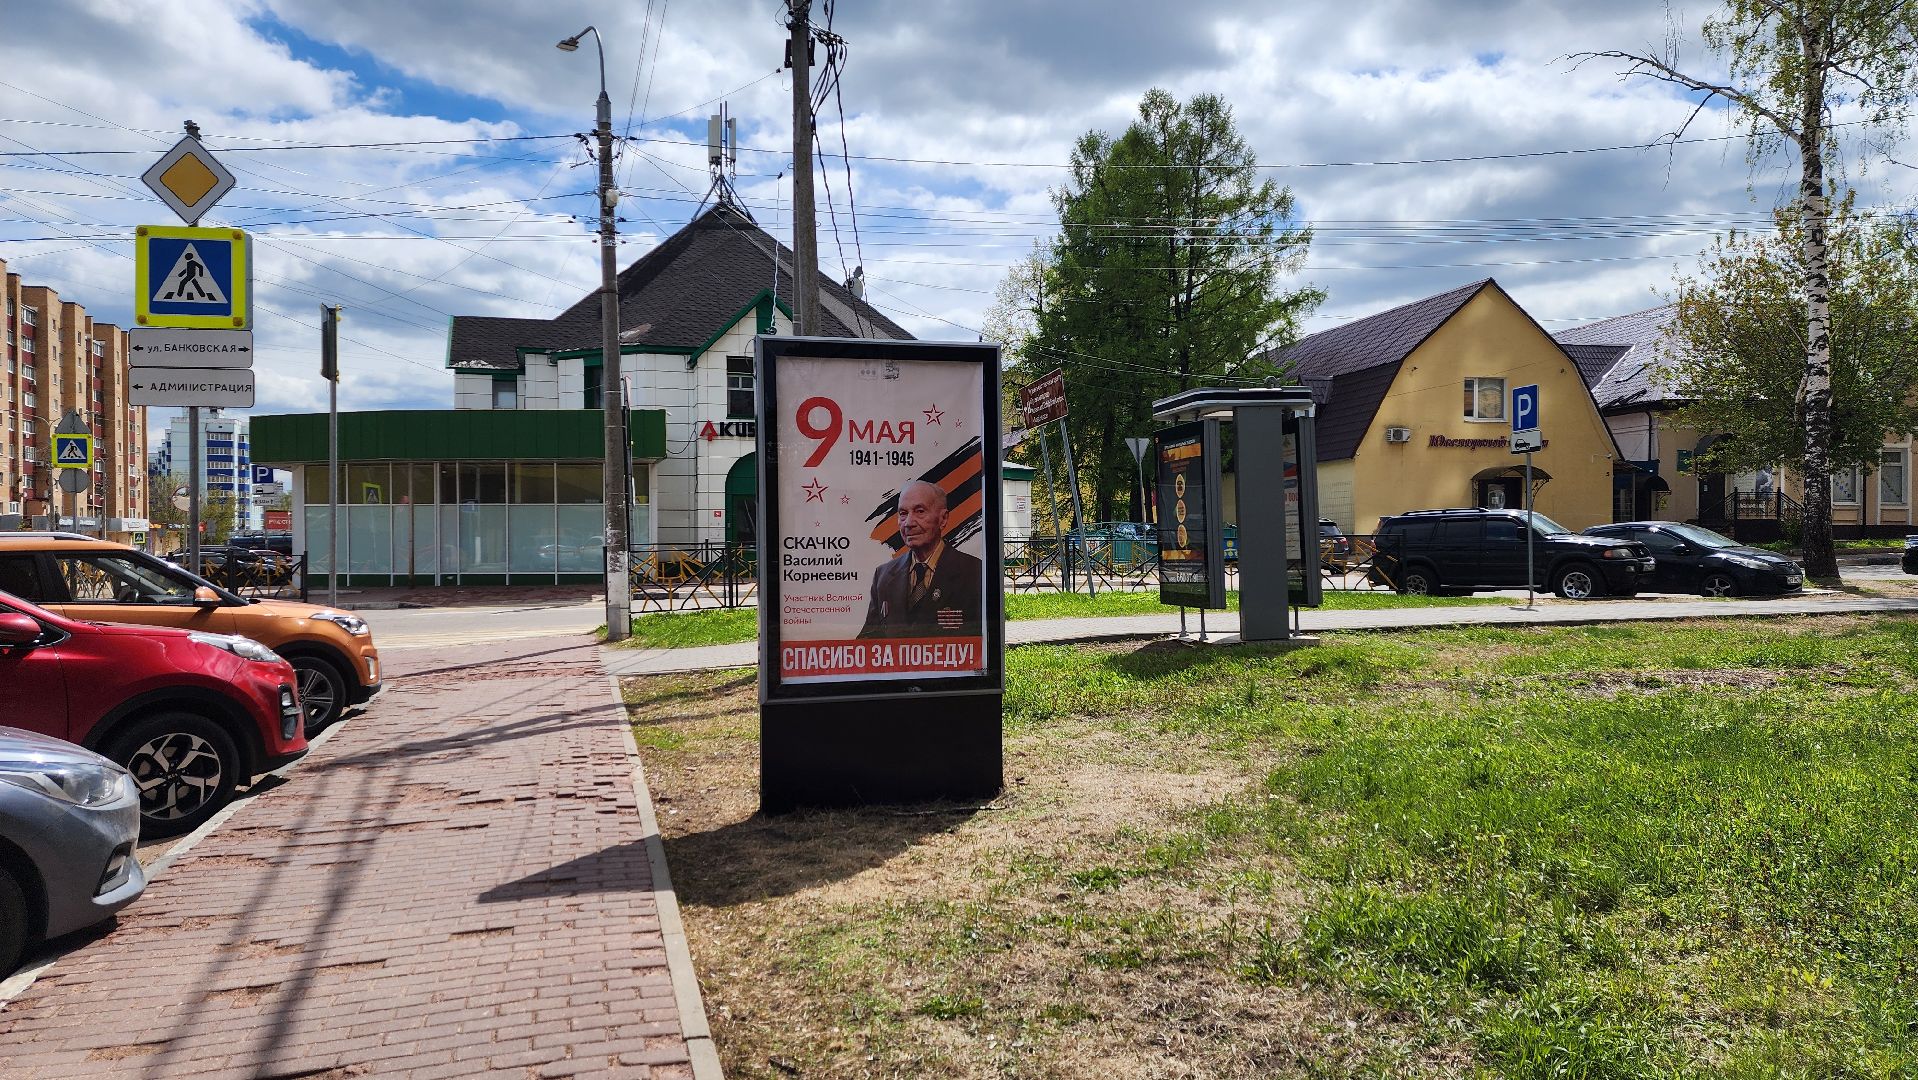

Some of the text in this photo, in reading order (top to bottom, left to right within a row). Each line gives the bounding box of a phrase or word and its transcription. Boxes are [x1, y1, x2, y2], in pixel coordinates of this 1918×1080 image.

[148, 344, 236, 353] ул. БАНКОВСКАЯ
[150, 383, 252, 393] АДМИНИСТРАЦИЯ
[796, 396, 915, 468] 9 МАЯ
[849, 450, 914, 467] 1941-1945
[783, 536, 850, 550] СКАЧКО
[783, 553, 843, 566] Василий
[783, 569, 858, 583] Корнеевич
[783, 593, 863, 602] Участник Великой
[783, 605, 851, 613] Отечественной
[783, 616, 812, 625] войны
[783, 643, 974, 670] СПАСИБО ЗА ПОБЕДУ!
